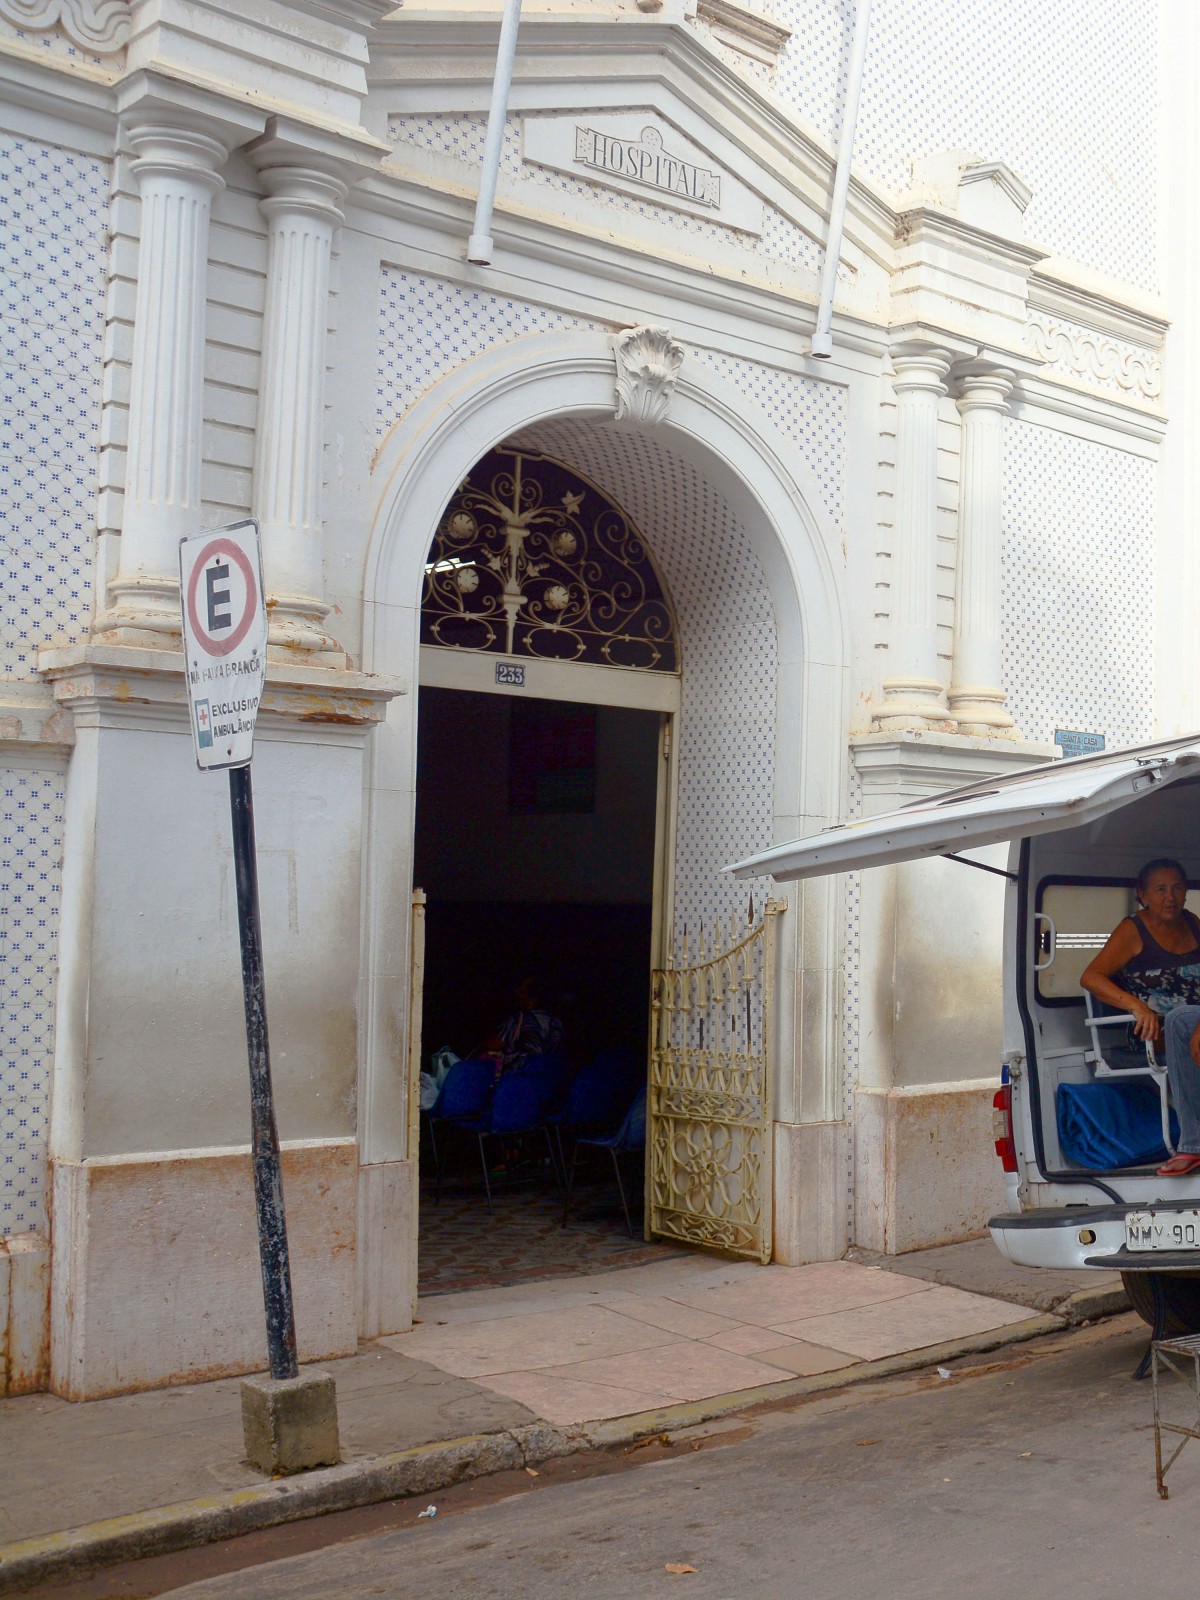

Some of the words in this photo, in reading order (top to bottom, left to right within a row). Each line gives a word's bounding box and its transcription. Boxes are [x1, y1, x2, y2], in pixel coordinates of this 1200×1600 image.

[593, 134, 705, 199] HOSPITAL
[206, 564, 231, 631] E
[499, 666, 522, 683] 233
[212, 697, 258, 717] EXCLUSIVO
[1083, 737, 1098, 746] CASA
